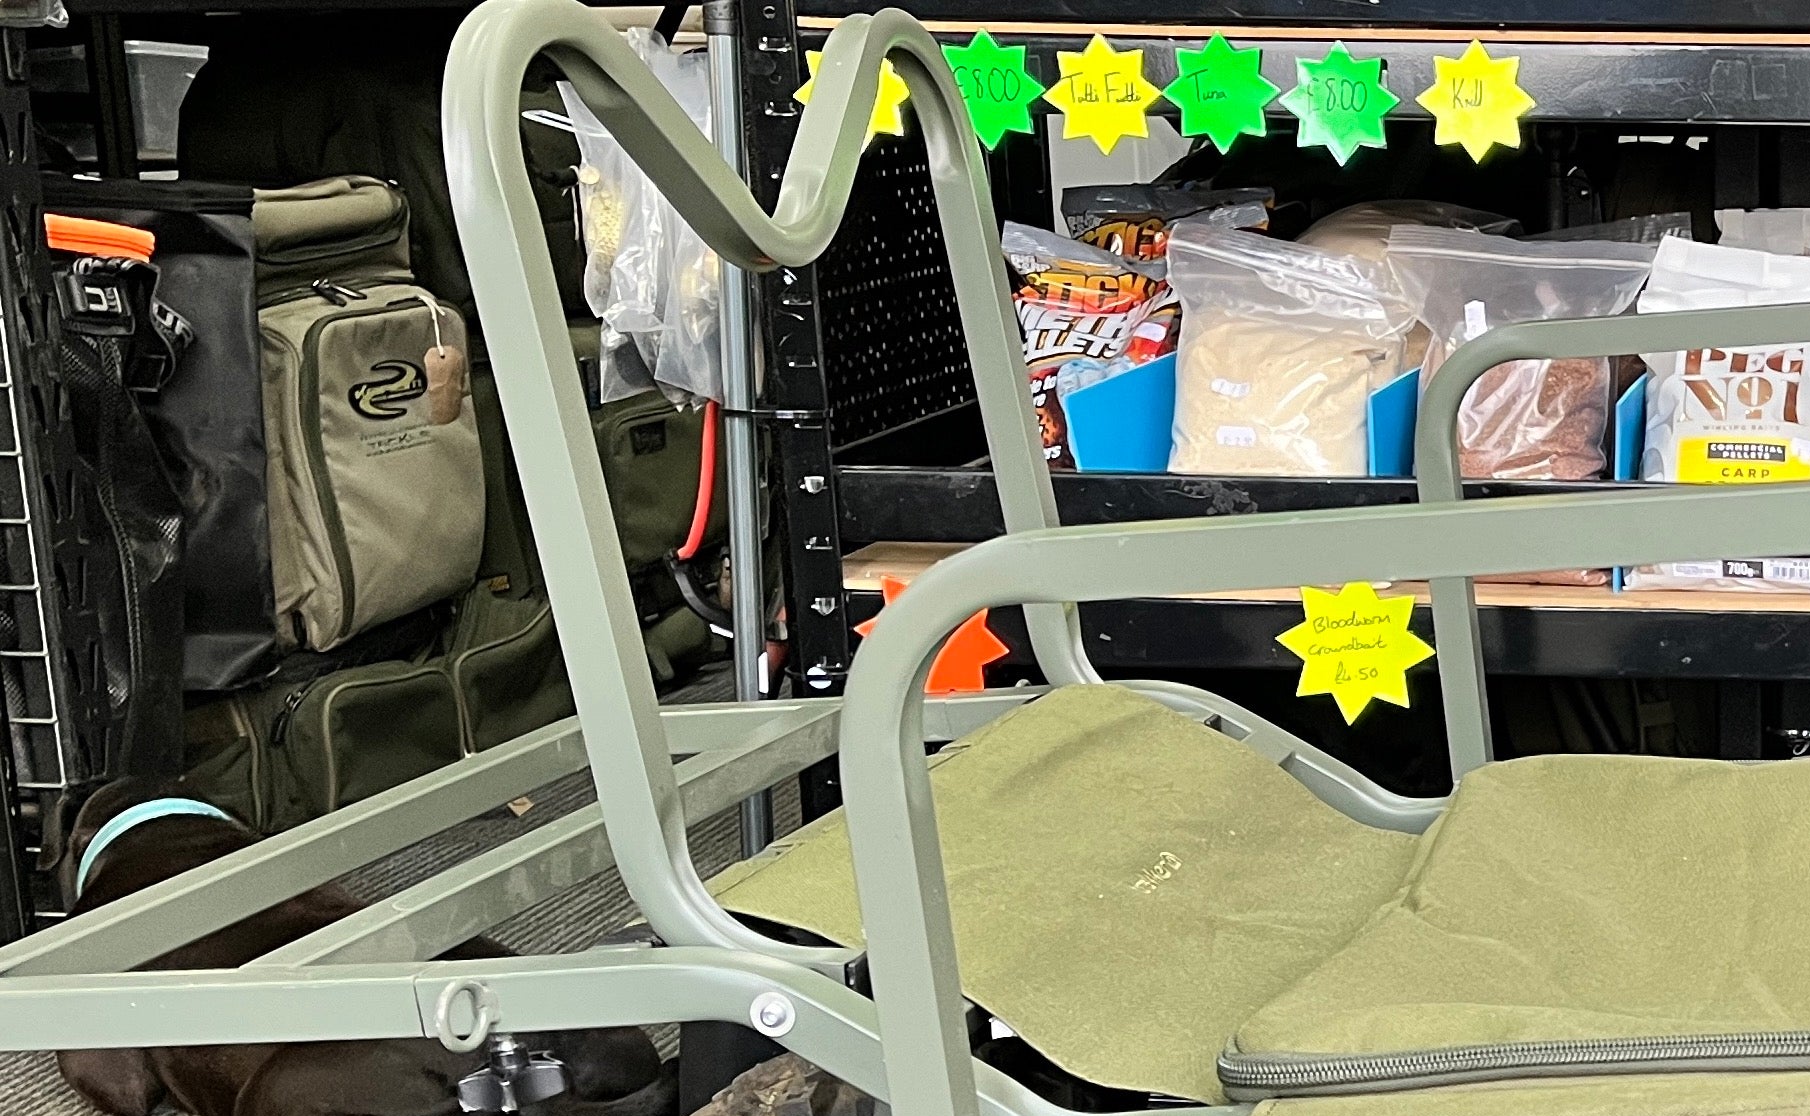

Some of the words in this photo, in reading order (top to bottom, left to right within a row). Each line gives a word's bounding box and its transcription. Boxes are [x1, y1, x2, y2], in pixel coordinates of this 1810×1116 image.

[1187, 69, 1227, 102] Tuna
[1685, 347, 1804, 375] PEG
[1710, 443, 1784, 454] COMMERCIAL
[1721, 467, 1770, 478] CARP
